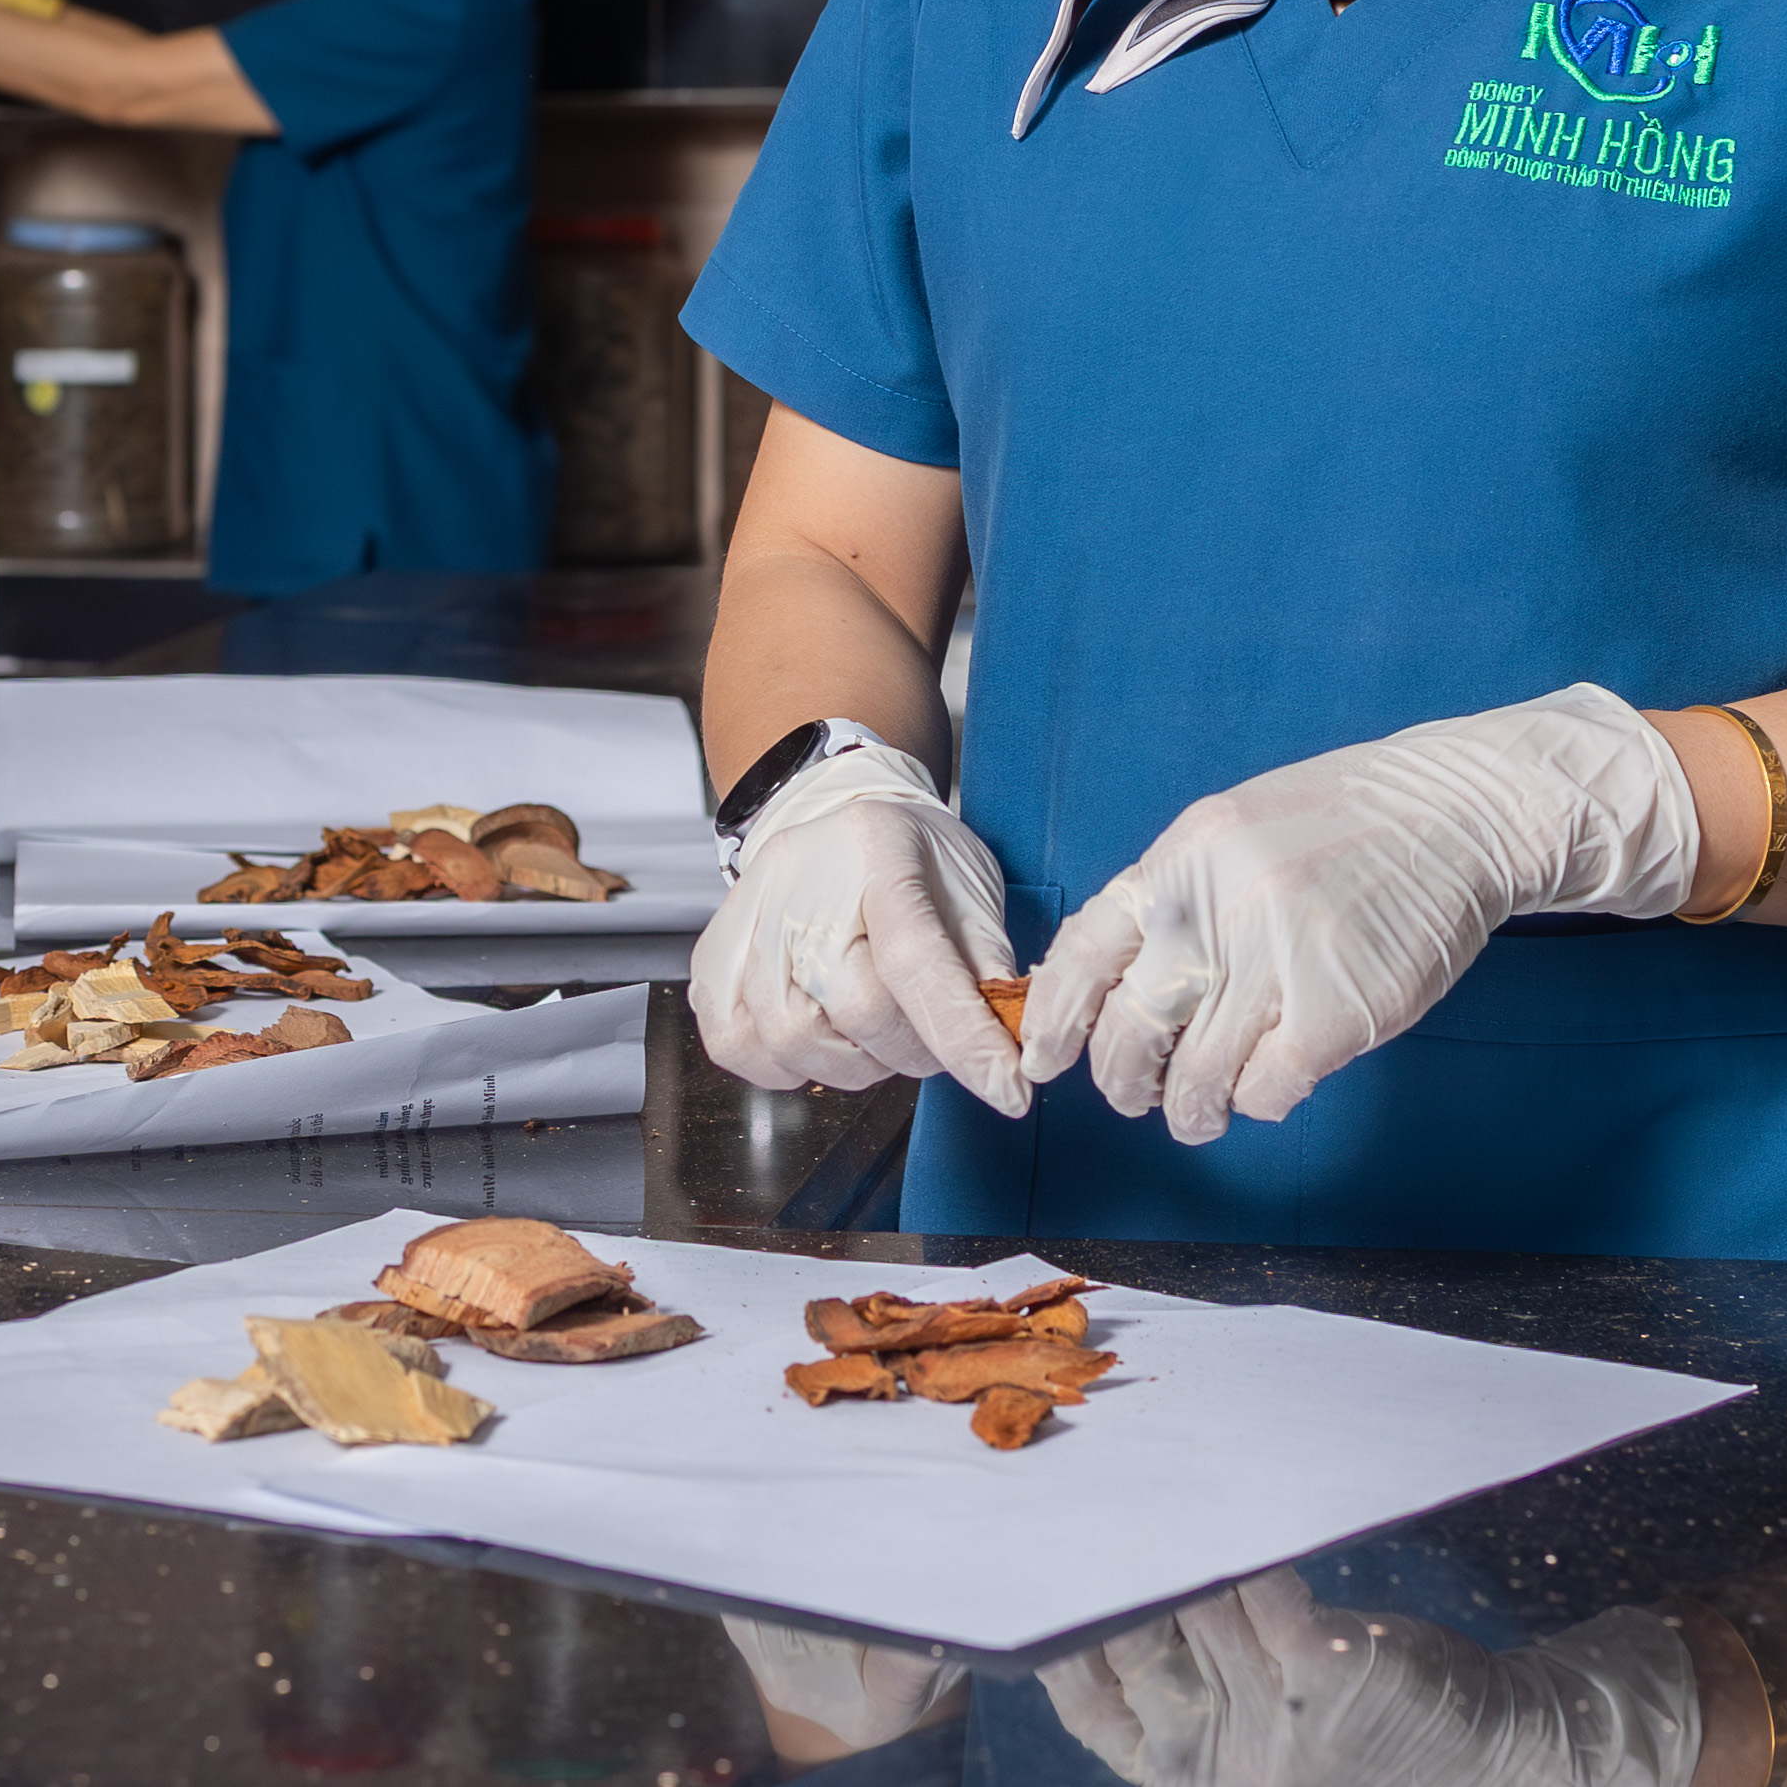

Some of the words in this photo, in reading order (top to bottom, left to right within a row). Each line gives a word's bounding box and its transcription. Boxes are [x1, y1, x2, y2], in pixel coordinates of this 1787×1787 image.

[1469, 80, 1526, 103] ĐÔNG
[1527, 85, 1544, 105] Y
[1454, 102, 1587, 161] MINH
[1596, 111, 1736, 184] HỒNG
[1444, 146, 1492, 169] ĐÔNG
[1492, 151, 1506, 170] Y
[483, 1075, 496, 1102] Minh
